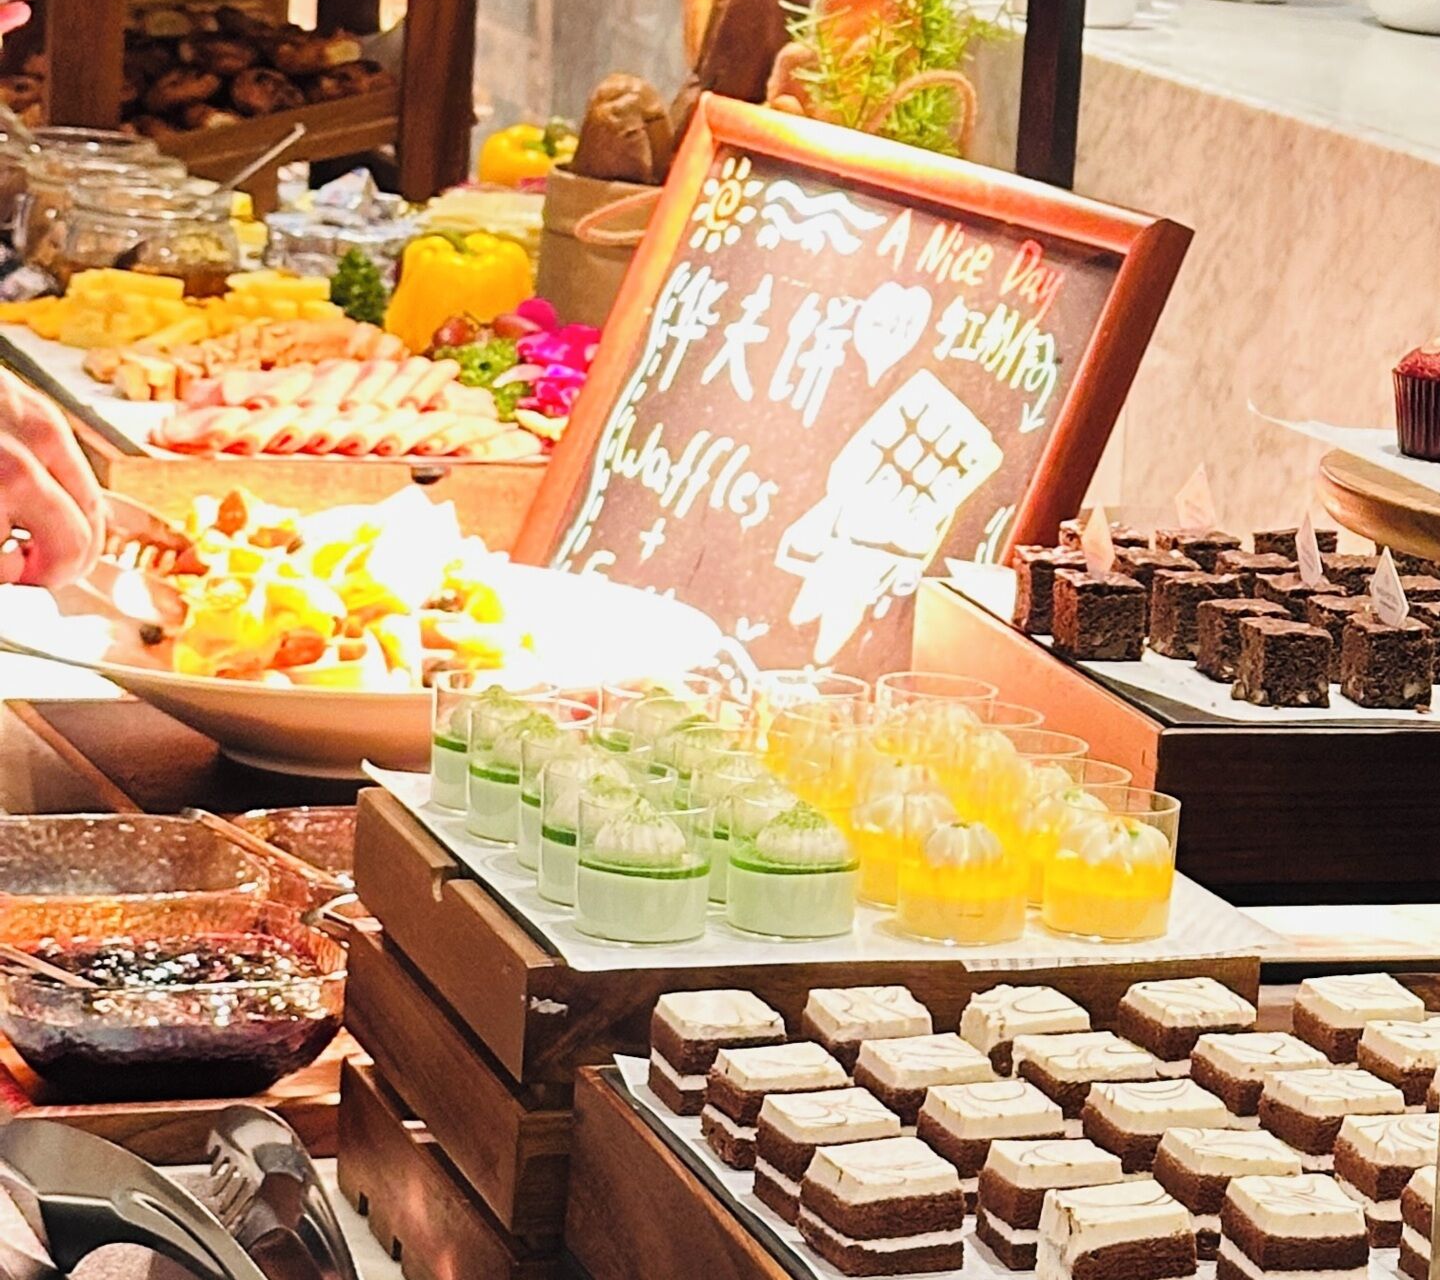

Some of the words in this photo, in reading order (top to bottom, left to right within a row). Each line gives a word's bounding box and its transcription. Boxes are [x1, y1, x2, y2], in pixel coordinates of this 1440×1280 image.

[877, 207, 912, 272] A
[916, 222, 994, 285] Nice
[999, 239, 1065, 327] Day
[612, 414, 780, 532] Waffles
